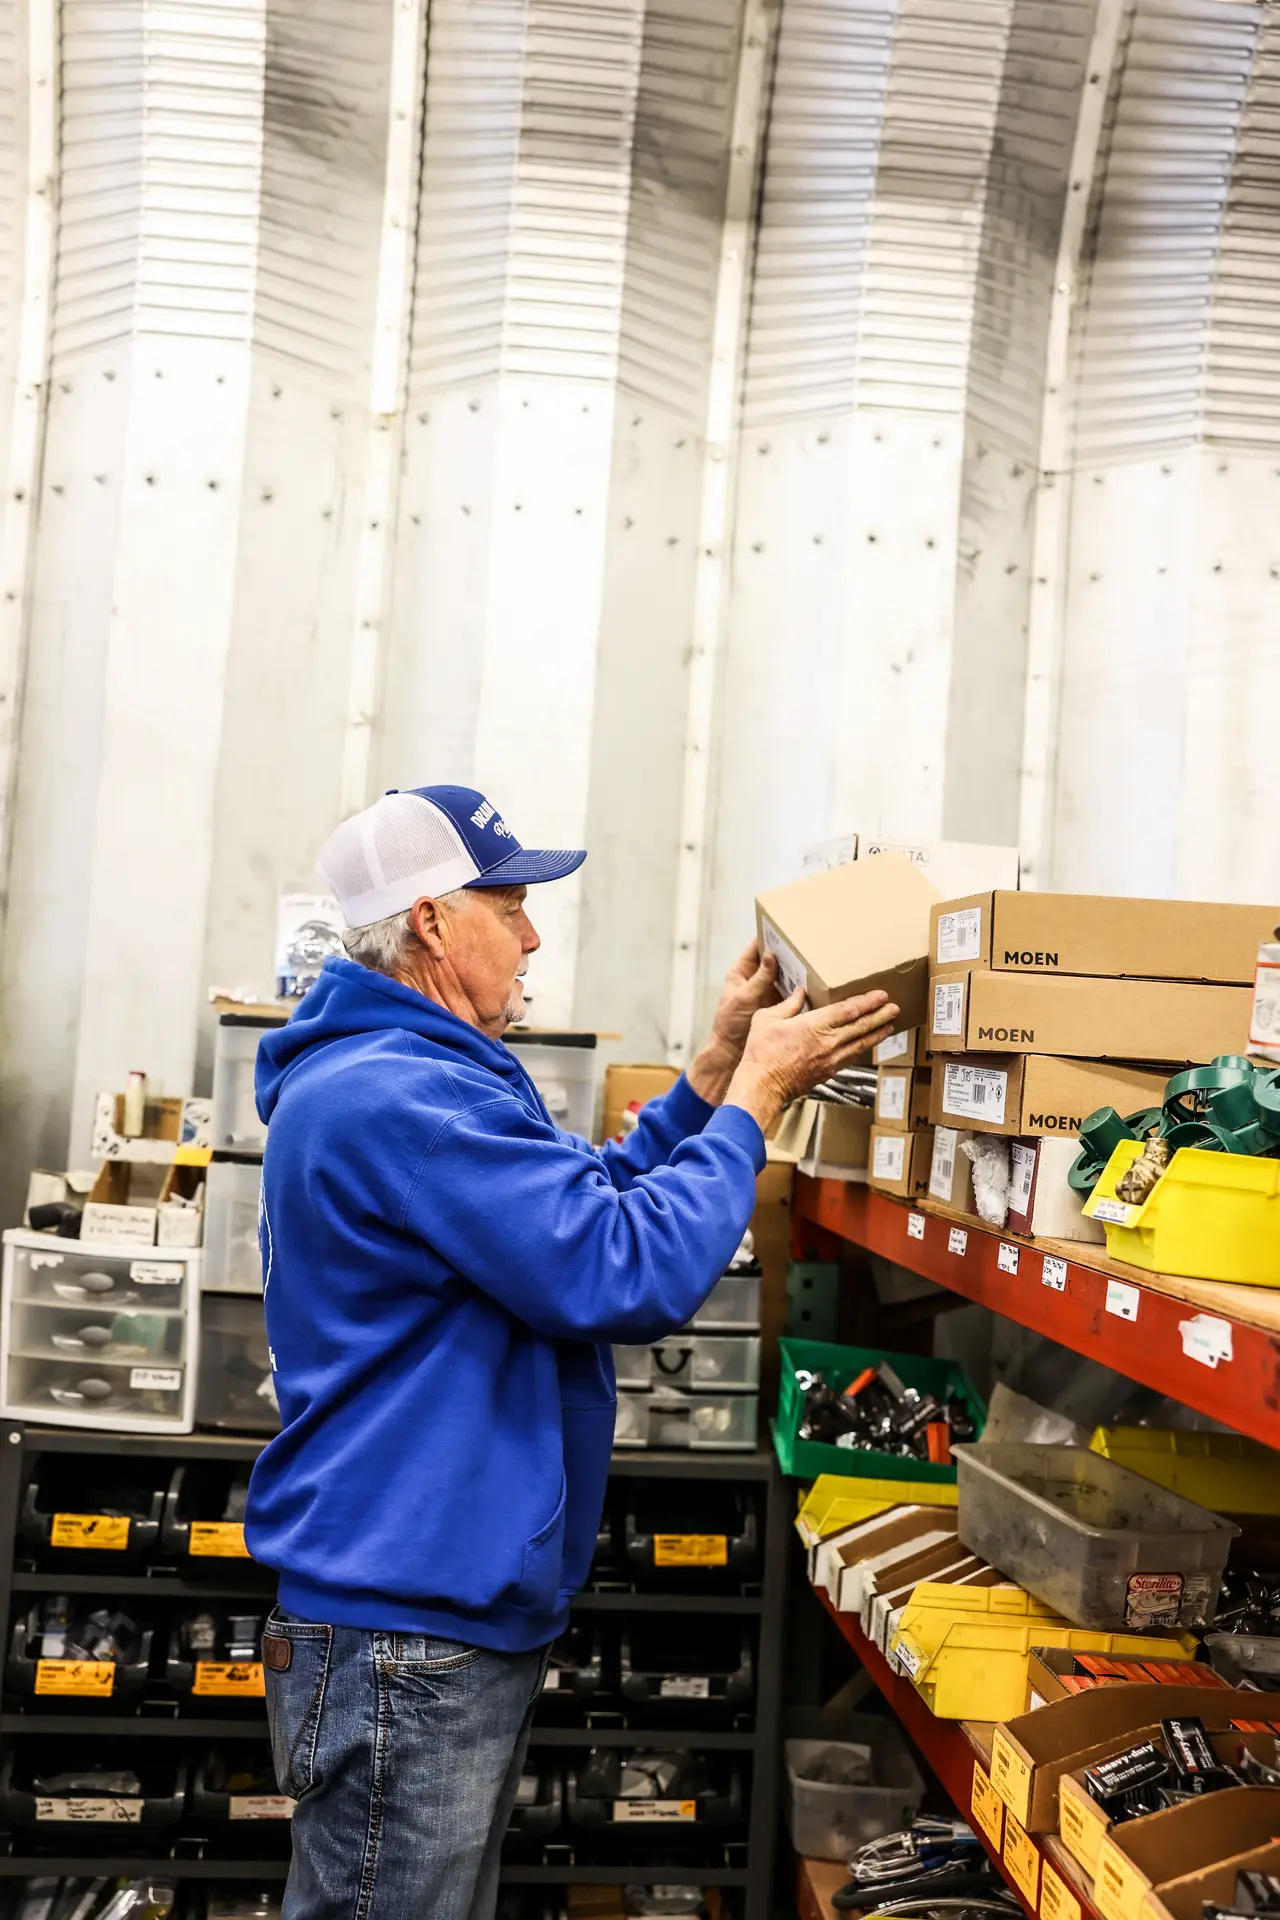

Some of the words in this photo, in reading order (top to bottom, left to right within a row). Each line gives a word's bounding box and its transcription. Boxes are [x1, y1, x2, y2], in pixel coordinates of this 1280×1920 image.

[1004, 951, 1059, 966] MOEN
[978, 1027, 1035, 1043] MOEN
[1029, 1113, 1081, 1130] MOEN
[1134, 1576, 1177, 1589] Sterilite
[1169, 1720, 1199, 1771] heavy-duty
[1096, 1743, 1154, 1774] heavy-duty
